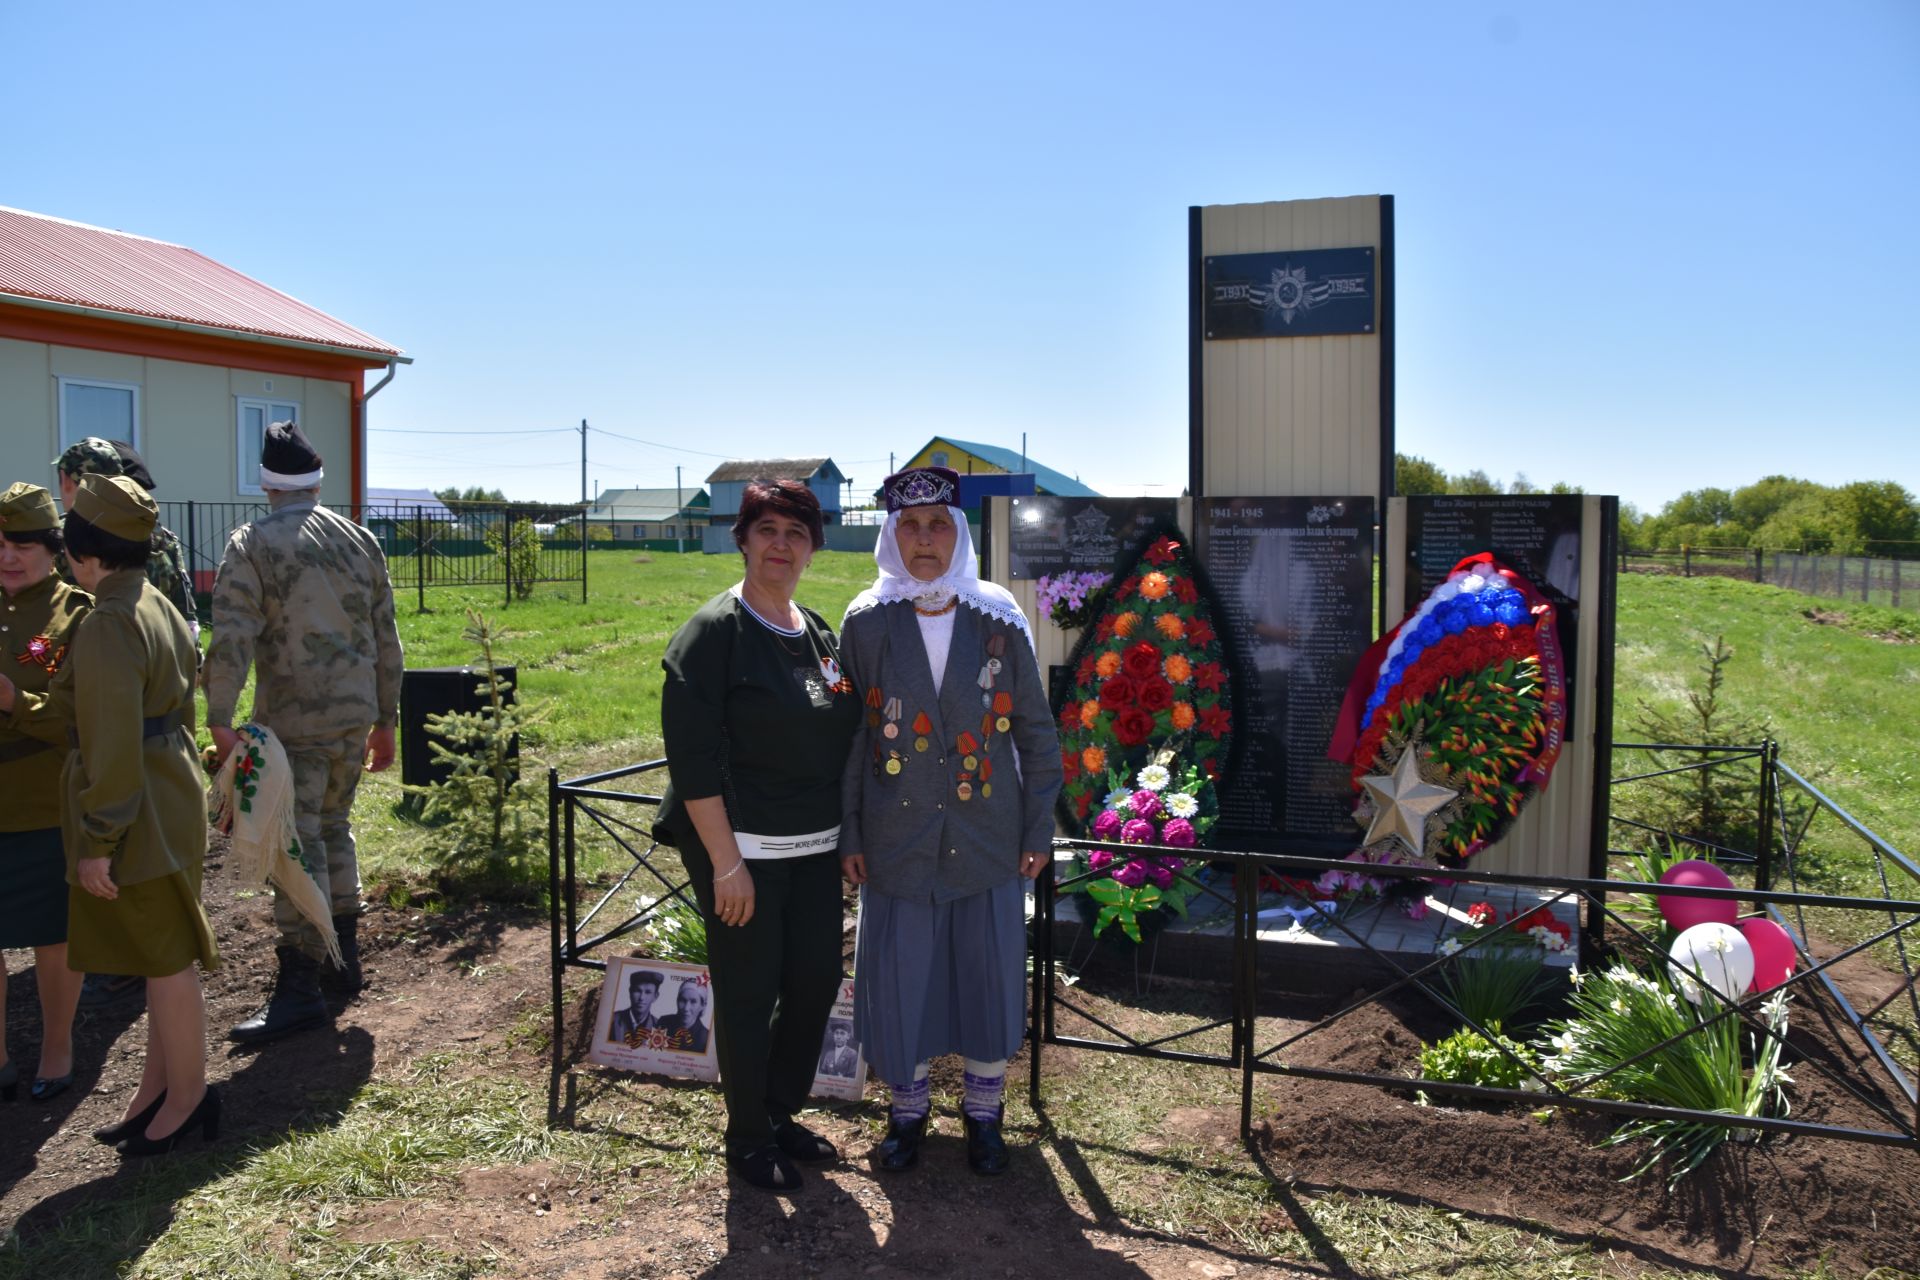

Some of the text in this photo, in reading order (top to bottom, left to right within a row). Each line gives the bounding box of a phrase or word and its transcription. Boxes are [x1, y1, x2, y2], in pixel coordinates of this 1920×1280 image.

[1223, 285, 1246, 299] 1941
[1331, 279, 1356, 294] 1945
[1210, 507, 1231, 519] 1941
[1241, 507, 1264, 519] 1945
